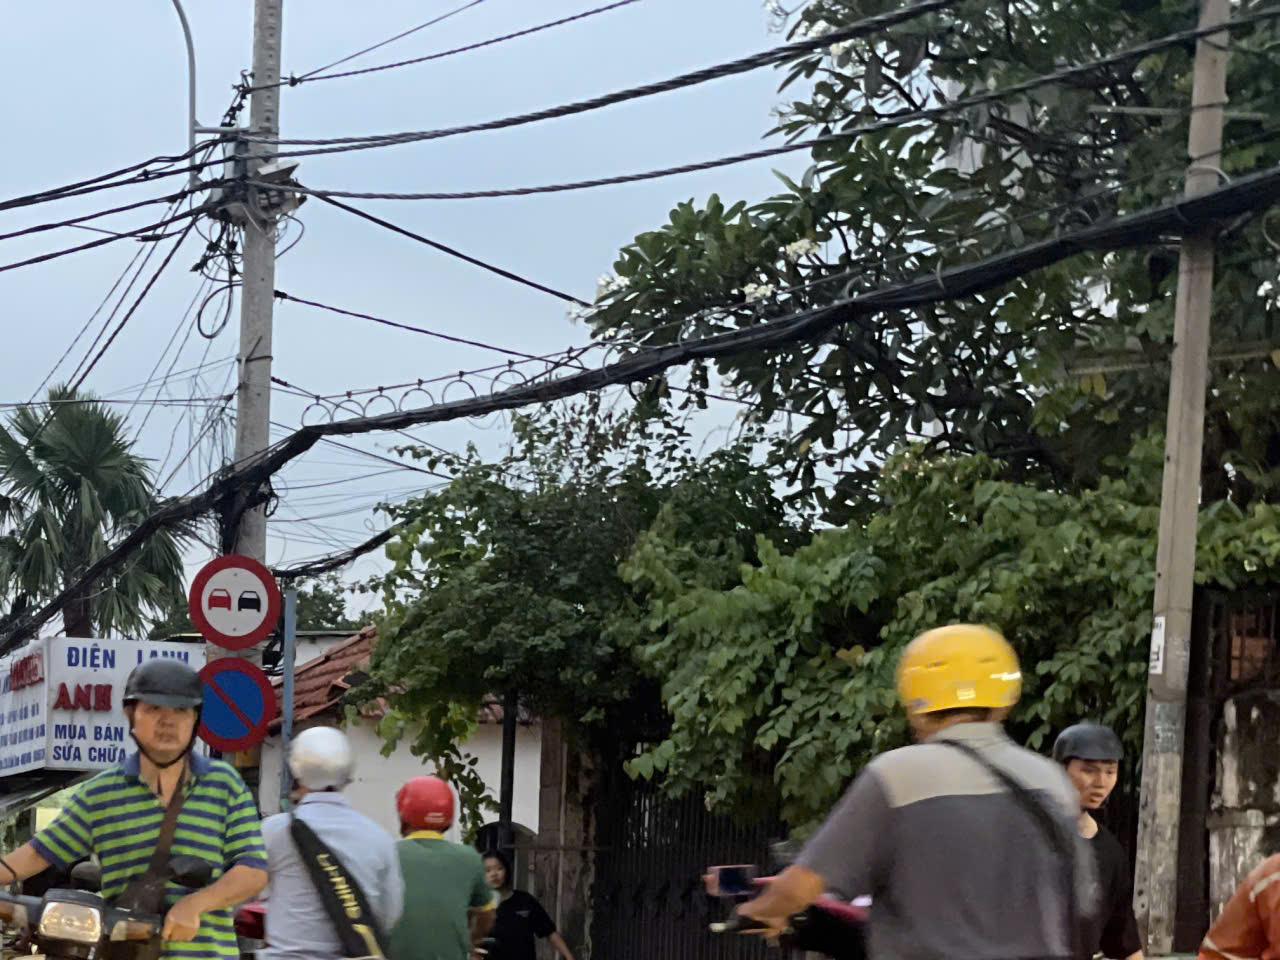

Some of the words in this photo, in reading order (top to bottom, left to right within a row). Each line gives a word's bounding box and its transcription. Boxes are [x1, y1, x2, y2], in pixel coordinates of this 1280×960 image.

[67, 643, 116, 673] ĐIỆN
[53, 682, 113, 711] ANH
[54, 724, 87, 740] MUA
[93, 723, 124, 742] BÁN
[52, 742, 82, 761] SỬA
